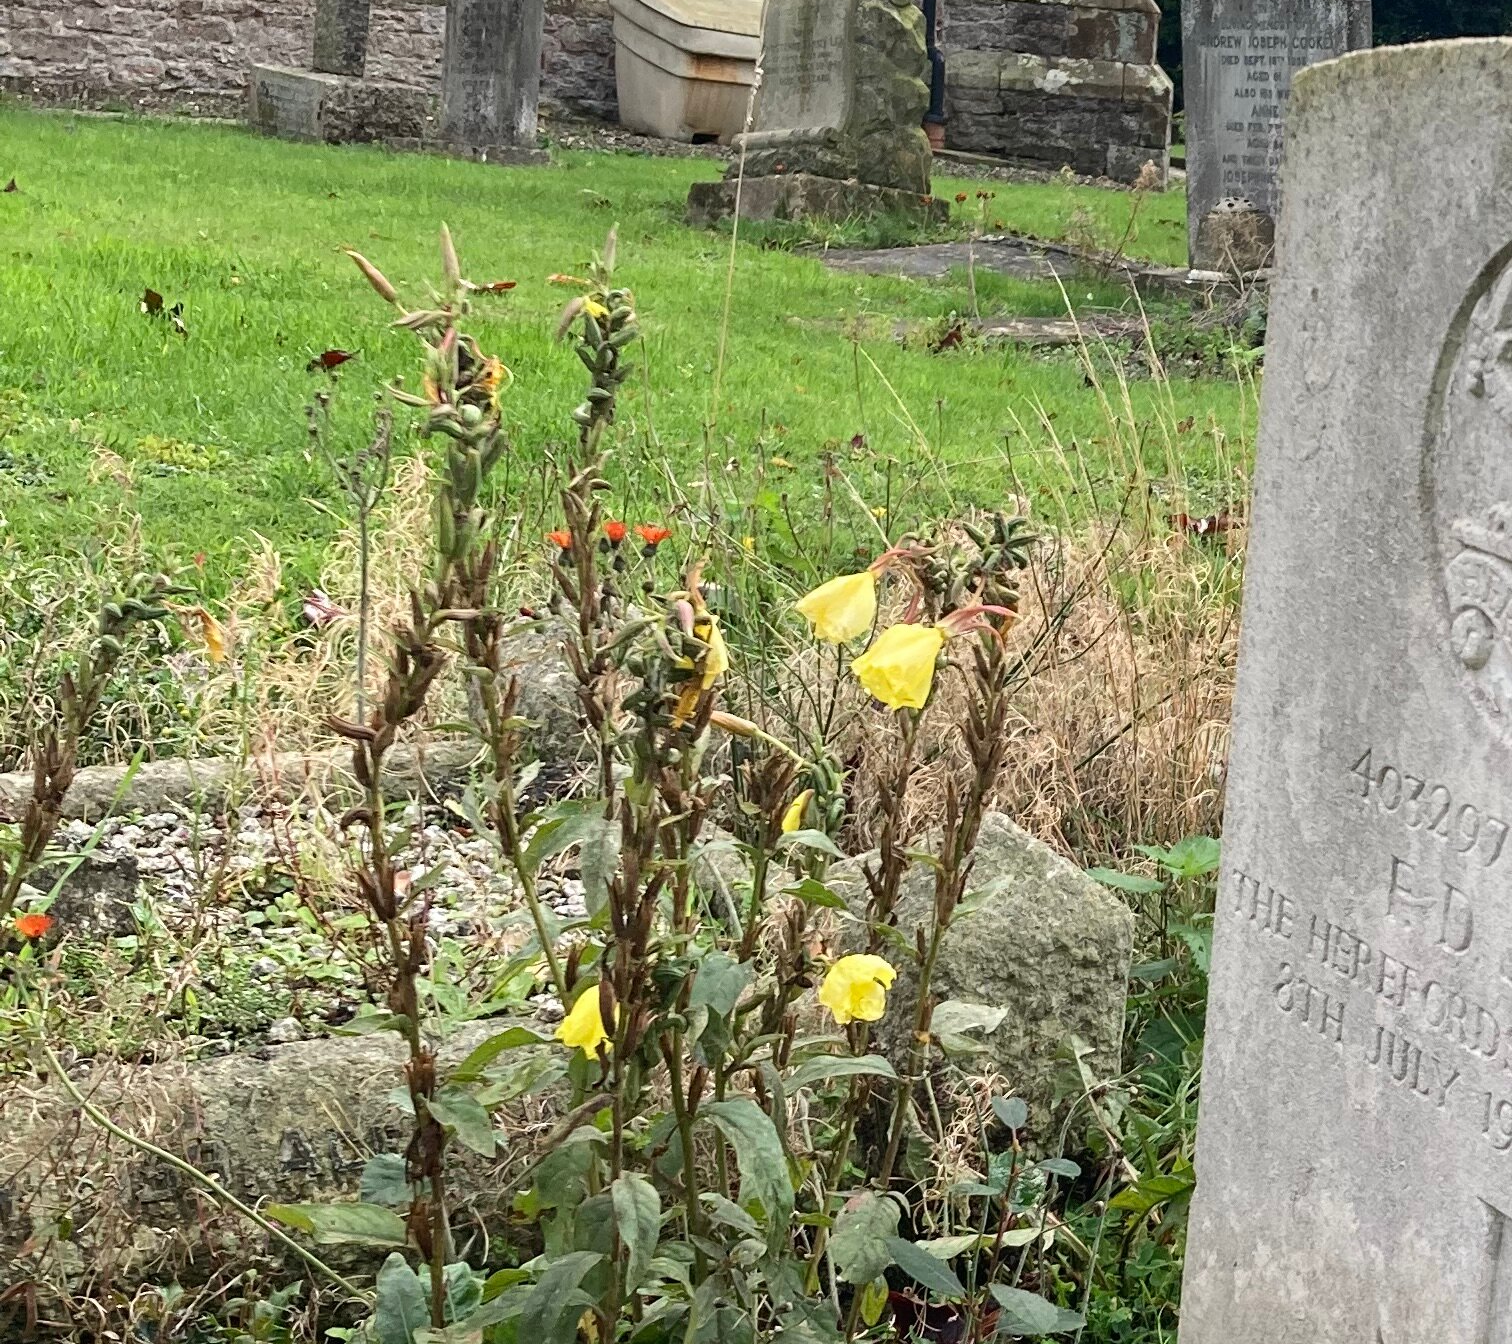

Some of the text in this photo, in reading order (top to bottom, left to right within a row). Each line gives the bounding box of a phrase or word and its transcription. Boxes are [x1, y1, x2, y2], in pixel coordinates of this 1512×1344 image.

[1248, 36, 1287, 49] JOSEPH
[1234, 88, 1256, 98] ALSO
[1232, 868, 1294, 940] THE
[1272, 961, 1345, 1044] 8TH
[1365, 1025, 1461, 1108] JULY
